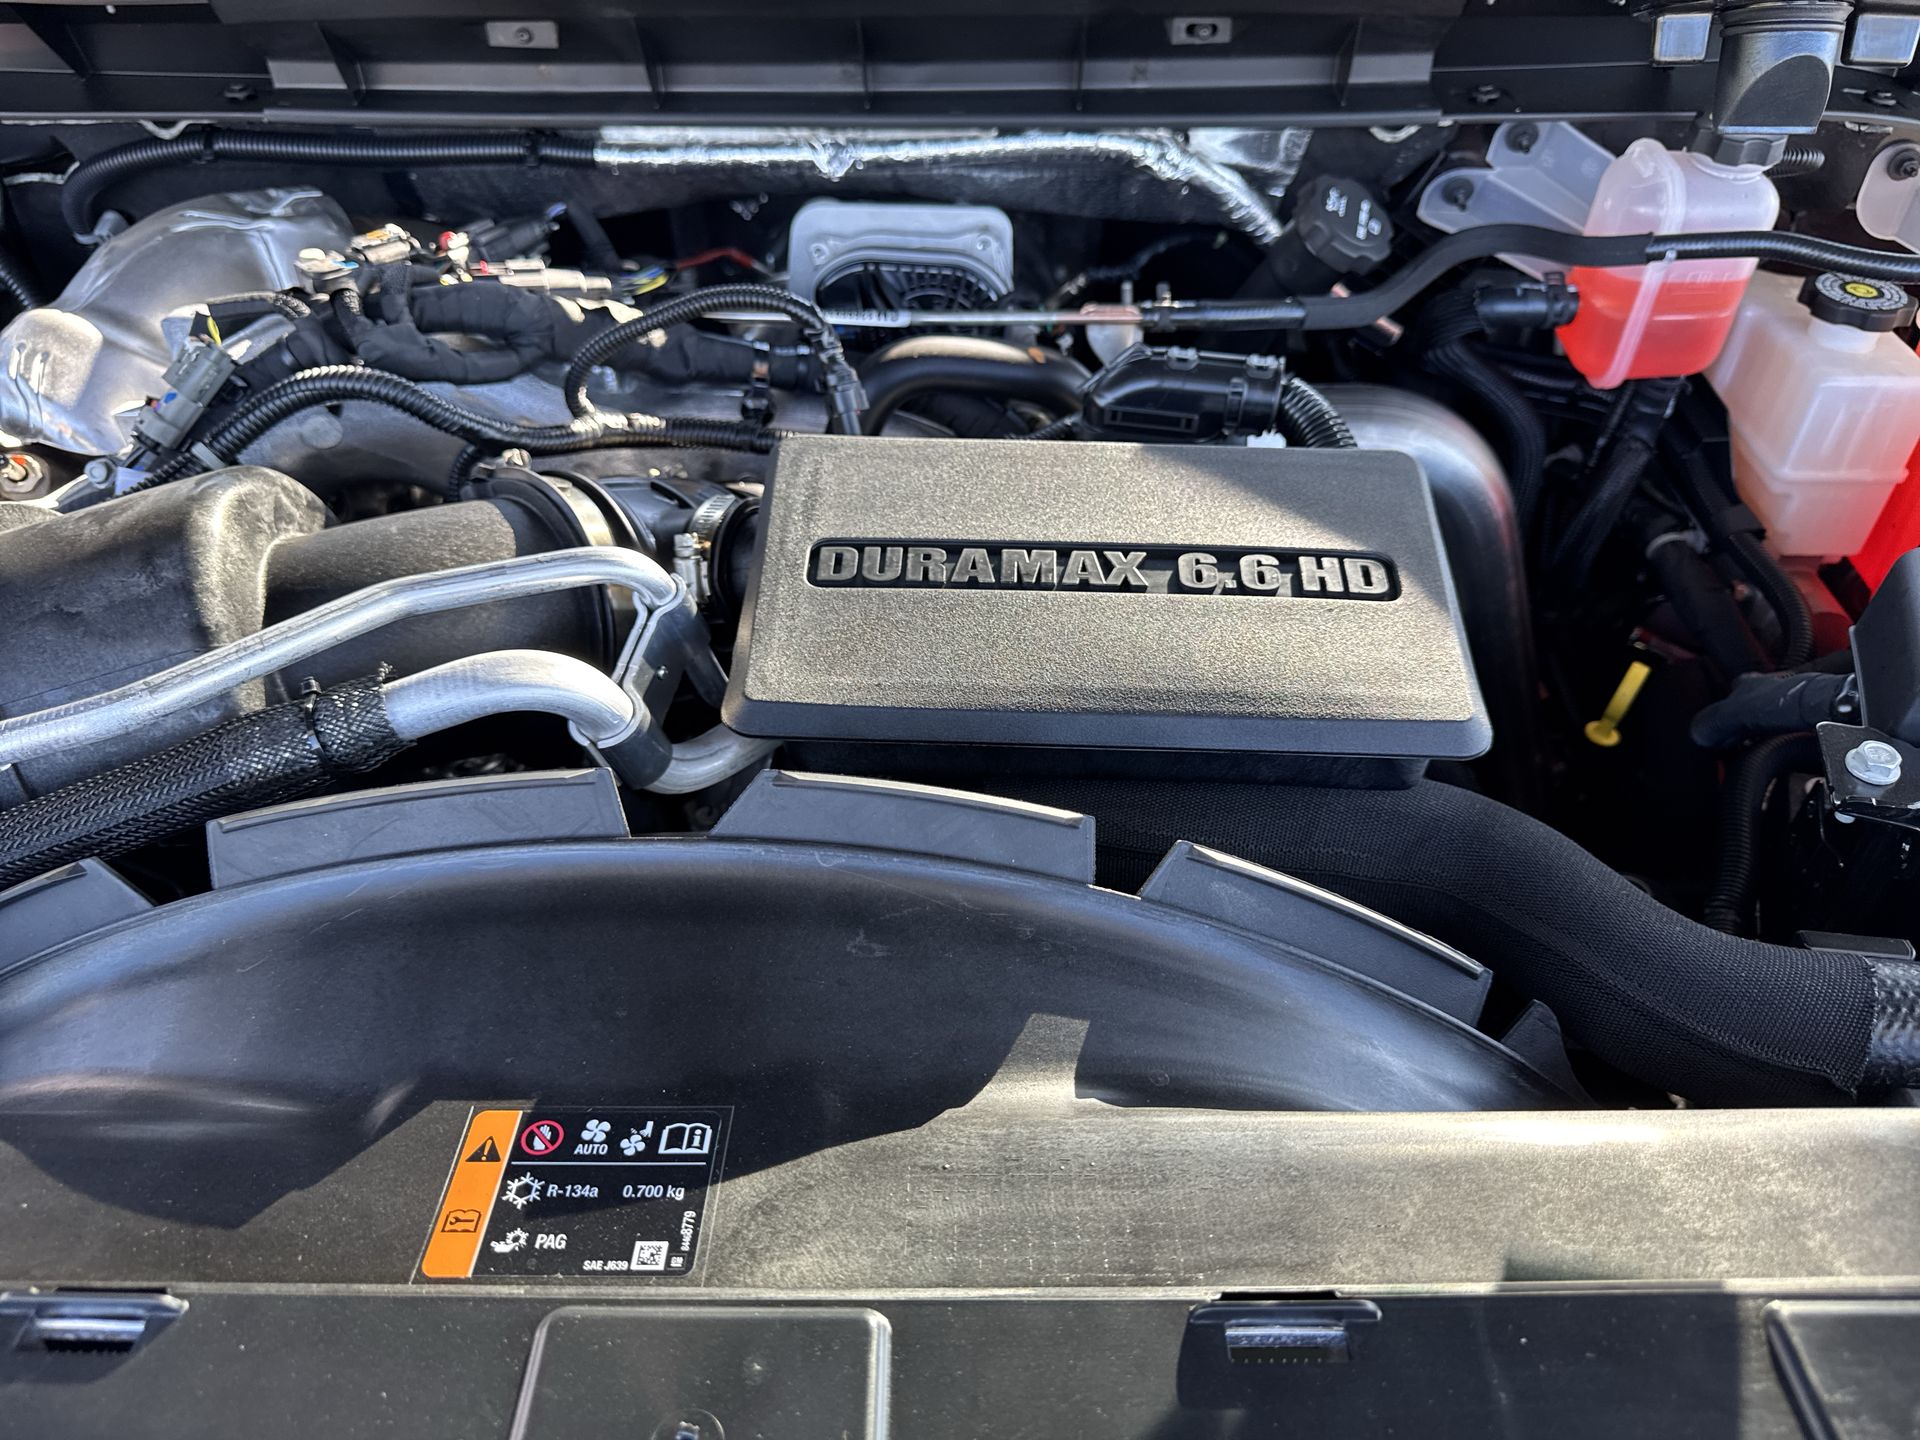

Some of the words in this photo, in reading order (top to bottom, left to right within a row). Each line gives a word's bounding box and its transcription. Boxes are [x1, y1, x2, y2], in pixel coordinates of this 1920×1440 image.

[816, 545, 1149, 587] DURAMAX
[1178, 551, 1281, 591] 6.6
[1299, 556, 1390, 594] HD
[574, 1143, 608, 1155] AUTO
[547, 1184, 599, 1198] R-134a
[622, 1184, 664, 1198] 0.700
[666, 1184, 685, 1201] kg
[535, 1233, 568, 1250] PAG
[582, 1259, 603, 1271] SAE
[604, 1259, 628, 1271] J639
